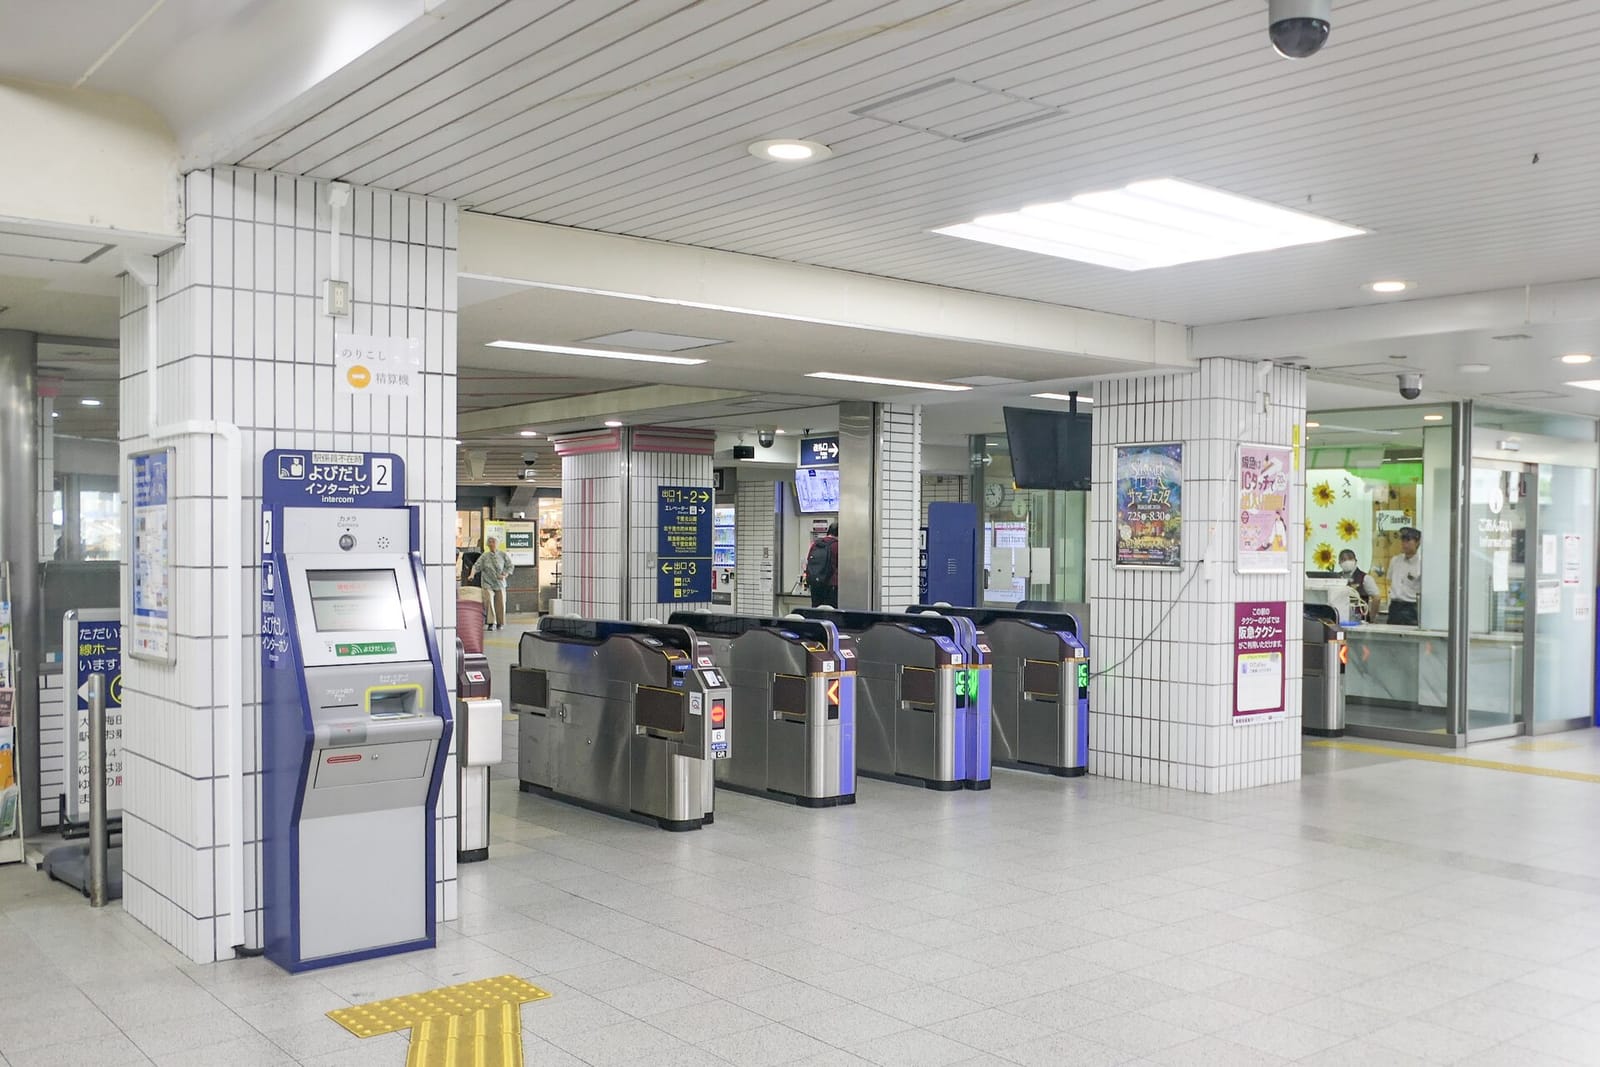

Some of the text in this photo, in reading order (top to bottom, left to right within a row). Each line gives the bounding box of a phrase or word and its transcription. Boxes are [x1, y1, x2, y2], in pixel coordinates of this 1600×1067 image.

[342, 349, 386, 361] のりこし
[376, 373, 409, 385] 精算機
[308, 466, 367, 482] よびだし
[376, 465, 388, 486] 2
[305, 483, 370, 495] インターホン
[661, 490, 675, 498] 出口
[321, 495, 355, 503] intercom
[1127, 488, 1171, 508] サマーフェスタ
[265, 520, 270, 545] 2
[673, 561, 697, 575] 出口 3
[262, 616, 285, 636] よびだし
[1240, 616, 1280, 624] タクシーのりばでは
[79, 628, 122, 641] ただい
[1238, 626, 1282, 640] 阪急タクシー
[79, 643, 122, 656] 線ホー
[262, 637, 289, 653] インターホン
